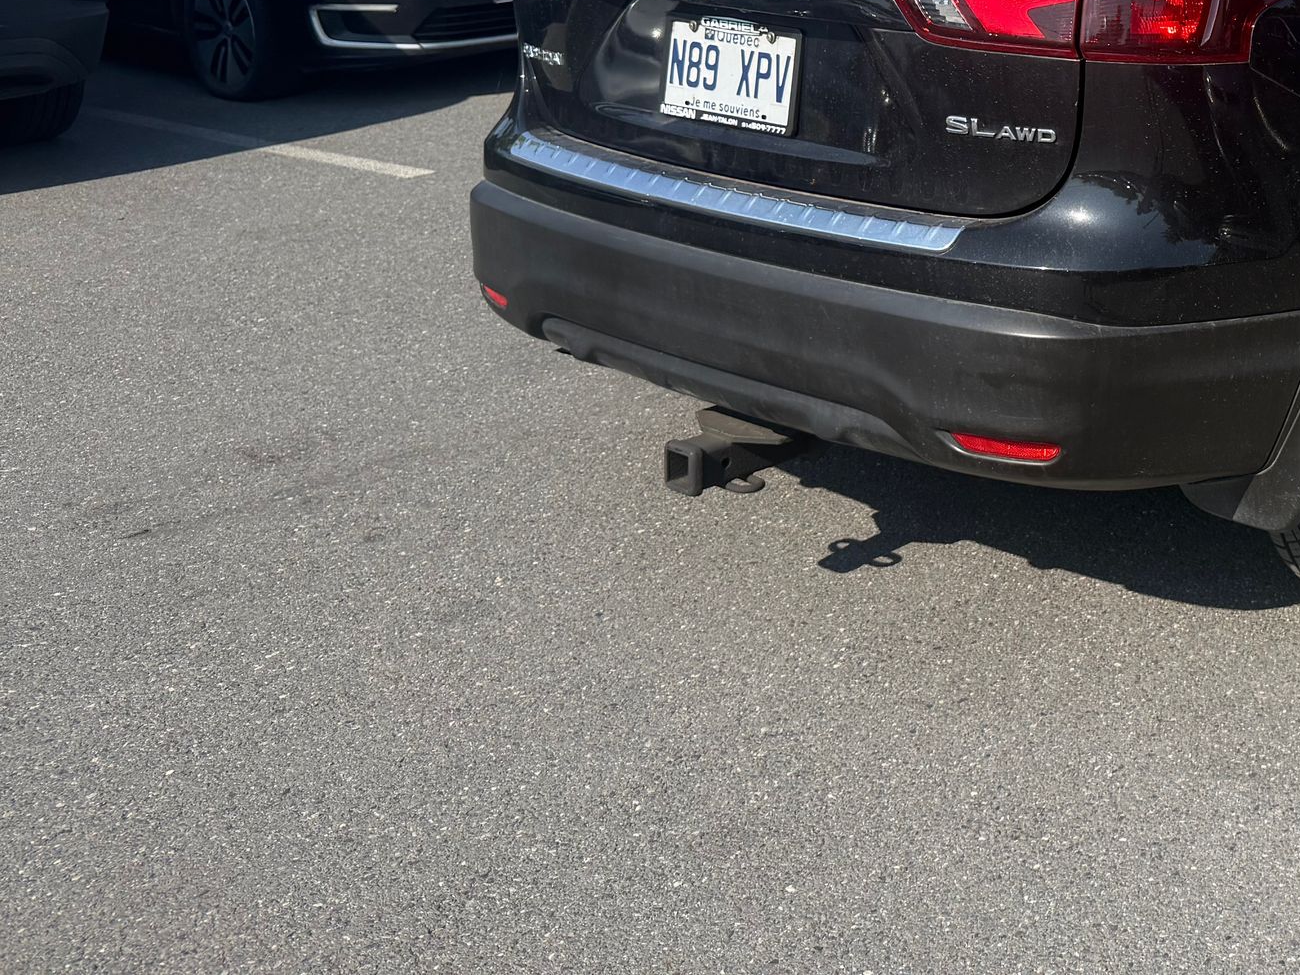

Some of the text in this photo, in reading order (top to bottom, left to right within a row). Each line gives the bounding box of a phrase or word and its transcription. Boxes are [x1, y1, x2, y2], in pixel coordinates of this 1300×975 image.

[669, 38, 791, 104] N89 XPV
[660, 103, 696, 120] NISSAN
[703, 101, 717, 111] me
[719, 104, 760, 119] souviens
[995, 125, 1057, 143] AWD
